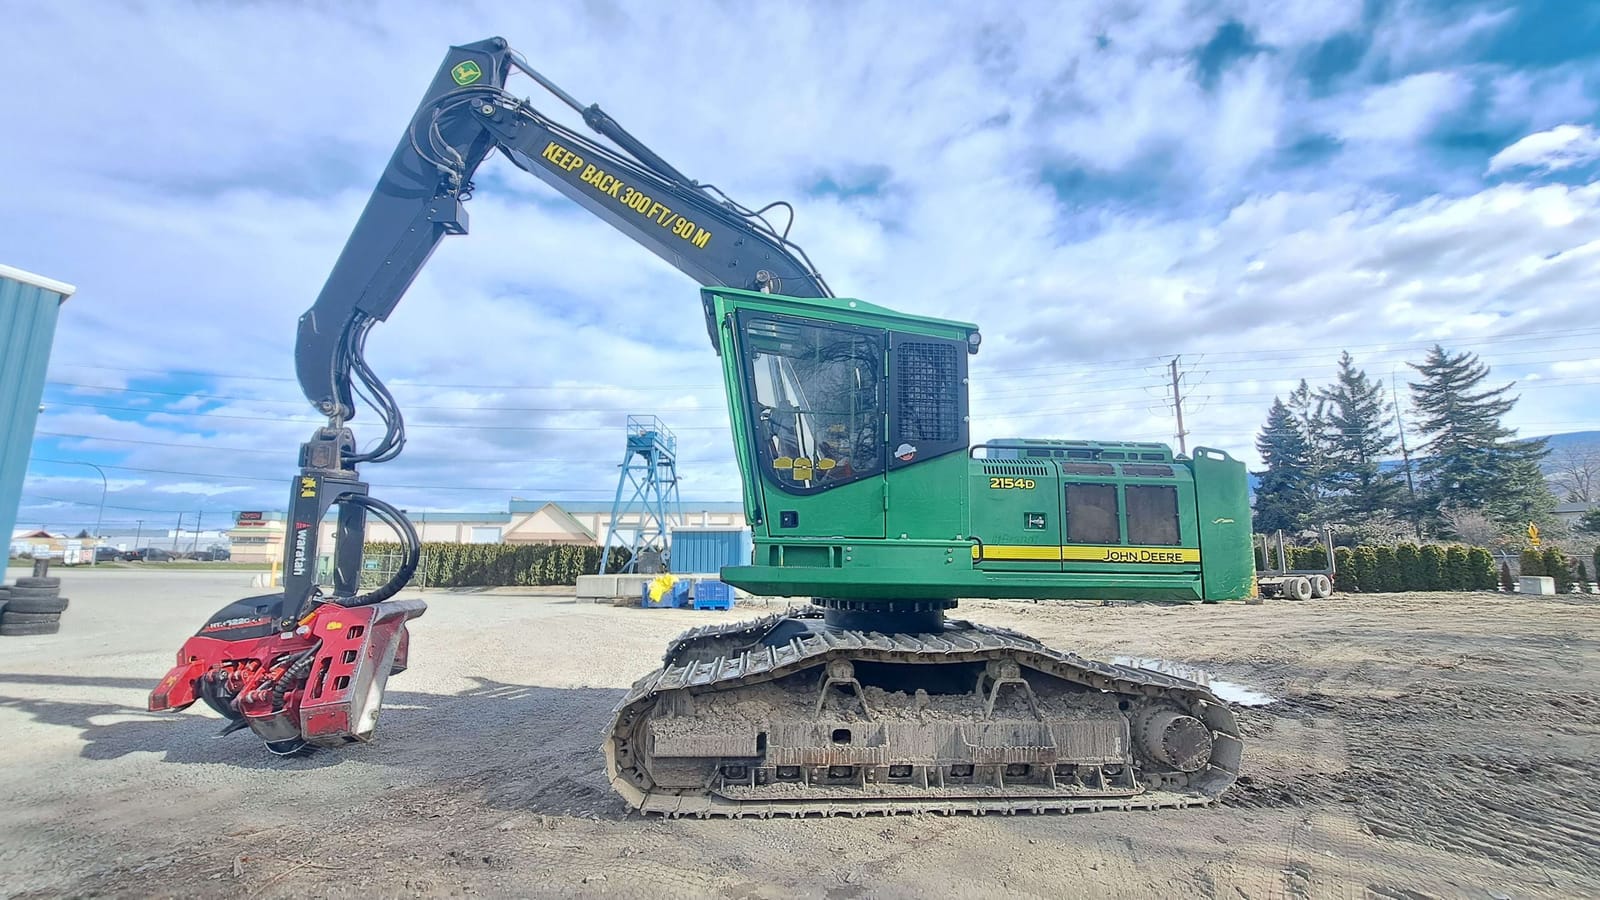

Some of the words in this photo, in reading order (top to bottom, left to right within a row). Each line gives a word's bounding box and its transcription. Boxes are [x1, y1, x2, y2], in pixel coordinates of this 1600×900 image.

[543, 141, 583, 172] KEEP
[580, 165, 624, 198] BACK
[620, 187, 652, 213] 300
[692, 227, 712, 248] M
[990, 477, 1036, 489] 2154D
[1103, 549, 1138, 562] JOHN
[1140, 550, 1184, 563] DEERE
